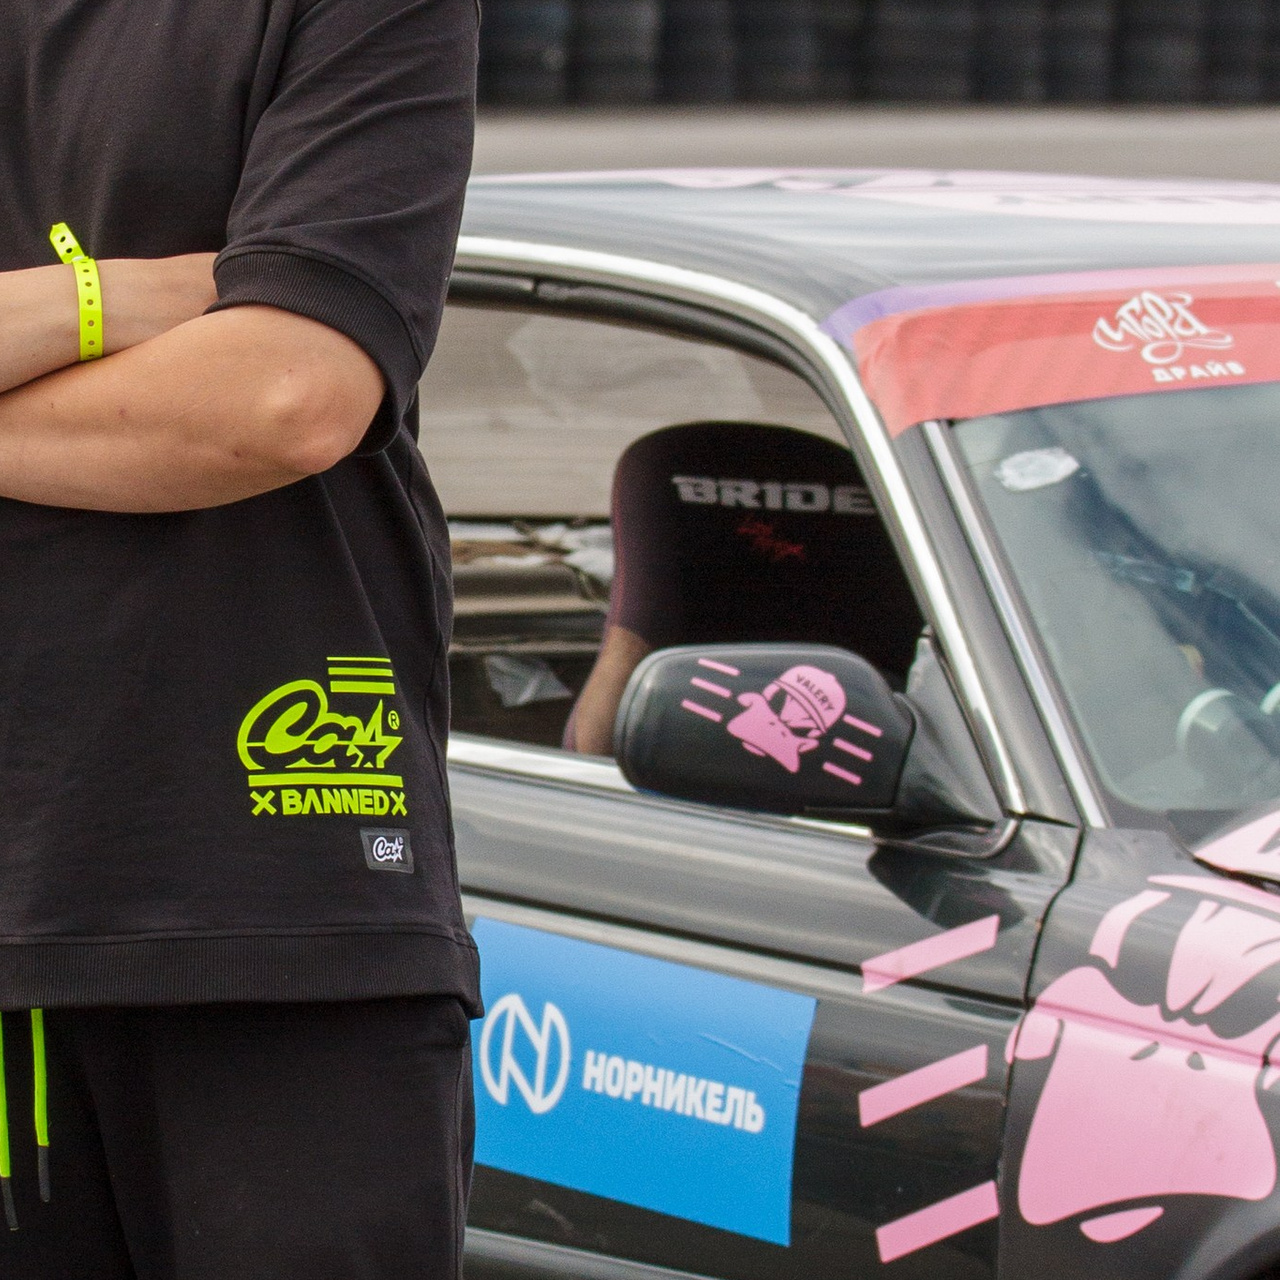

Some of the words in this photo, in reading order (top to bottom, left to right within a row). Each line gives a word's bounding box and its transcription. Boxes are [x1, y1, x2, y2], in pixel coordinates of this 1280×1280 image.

[671, 474, 878, 516] BRIDE
[796, 673, 836, 711] VALERY
[582, 1049, 766, 1134] НОРНИКЕЛЬ
